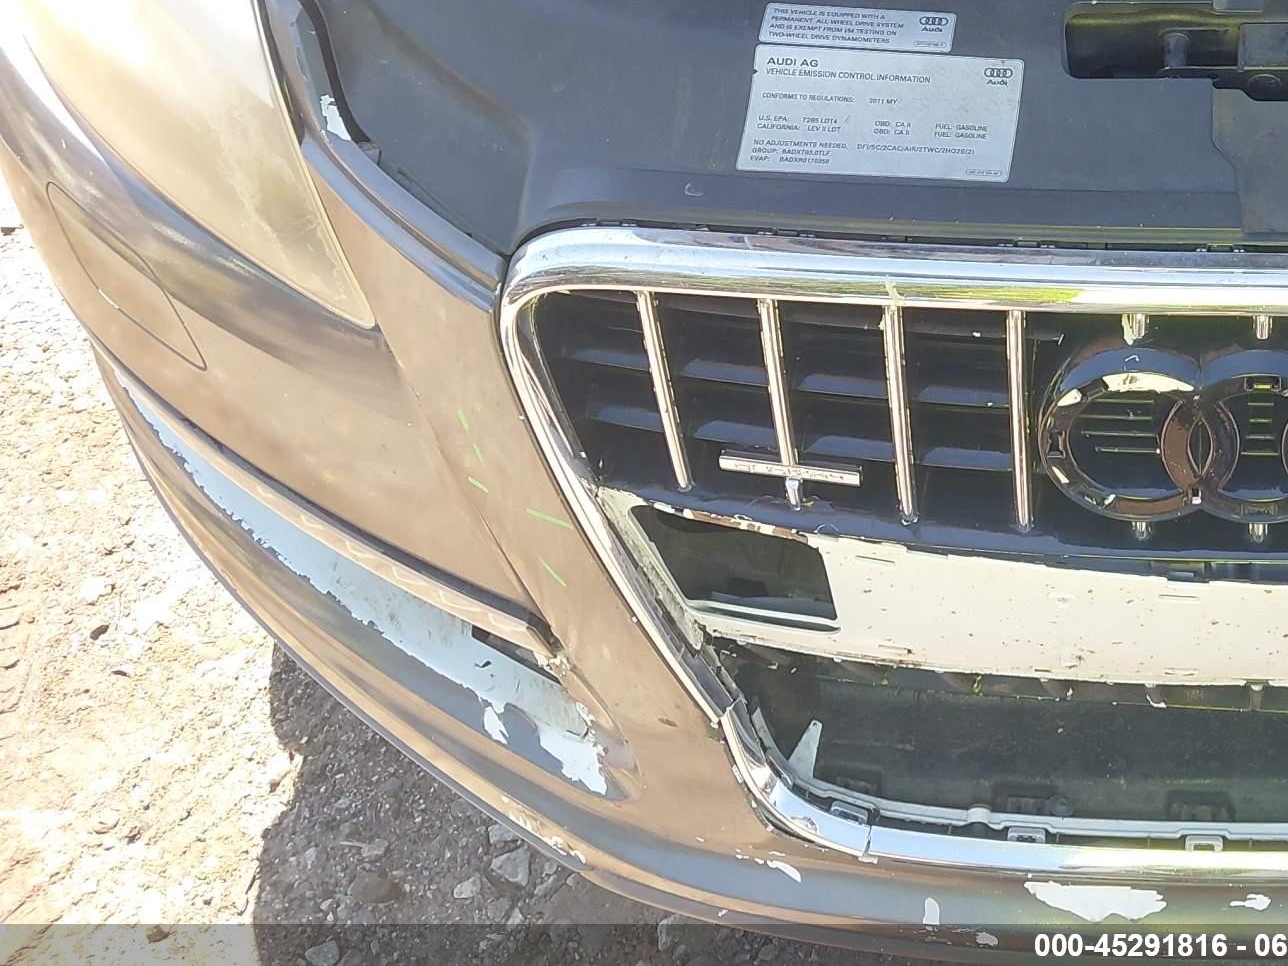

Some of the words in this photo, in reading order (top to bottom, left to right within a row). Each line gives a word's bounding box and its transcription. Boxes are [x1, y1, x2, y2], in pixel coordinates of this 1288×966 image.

[773, 7, 789, 15] THIS
[790, 8, 818, 16] VEHICLE
[826, 11, 860, 19] EQUIPPED
[771, 15, 813, 24] PERMANENT
[856, 28, 885, 36] TESTING
[921, 25, 943, 33] Audi
[810, 33, 831, 41] DRIVE
[766, 57, 797, 66] AUDI
[799, 59, 819, 68] AG
[766, 67, 797, 76] VEHICLE
[798, 69, 837, 78] EMISSION
[838, 71, 876, 81] CONTROL
[876, 74, 931, 83] INFORMATION
[762, 92, 798, 100] CONFORMS
